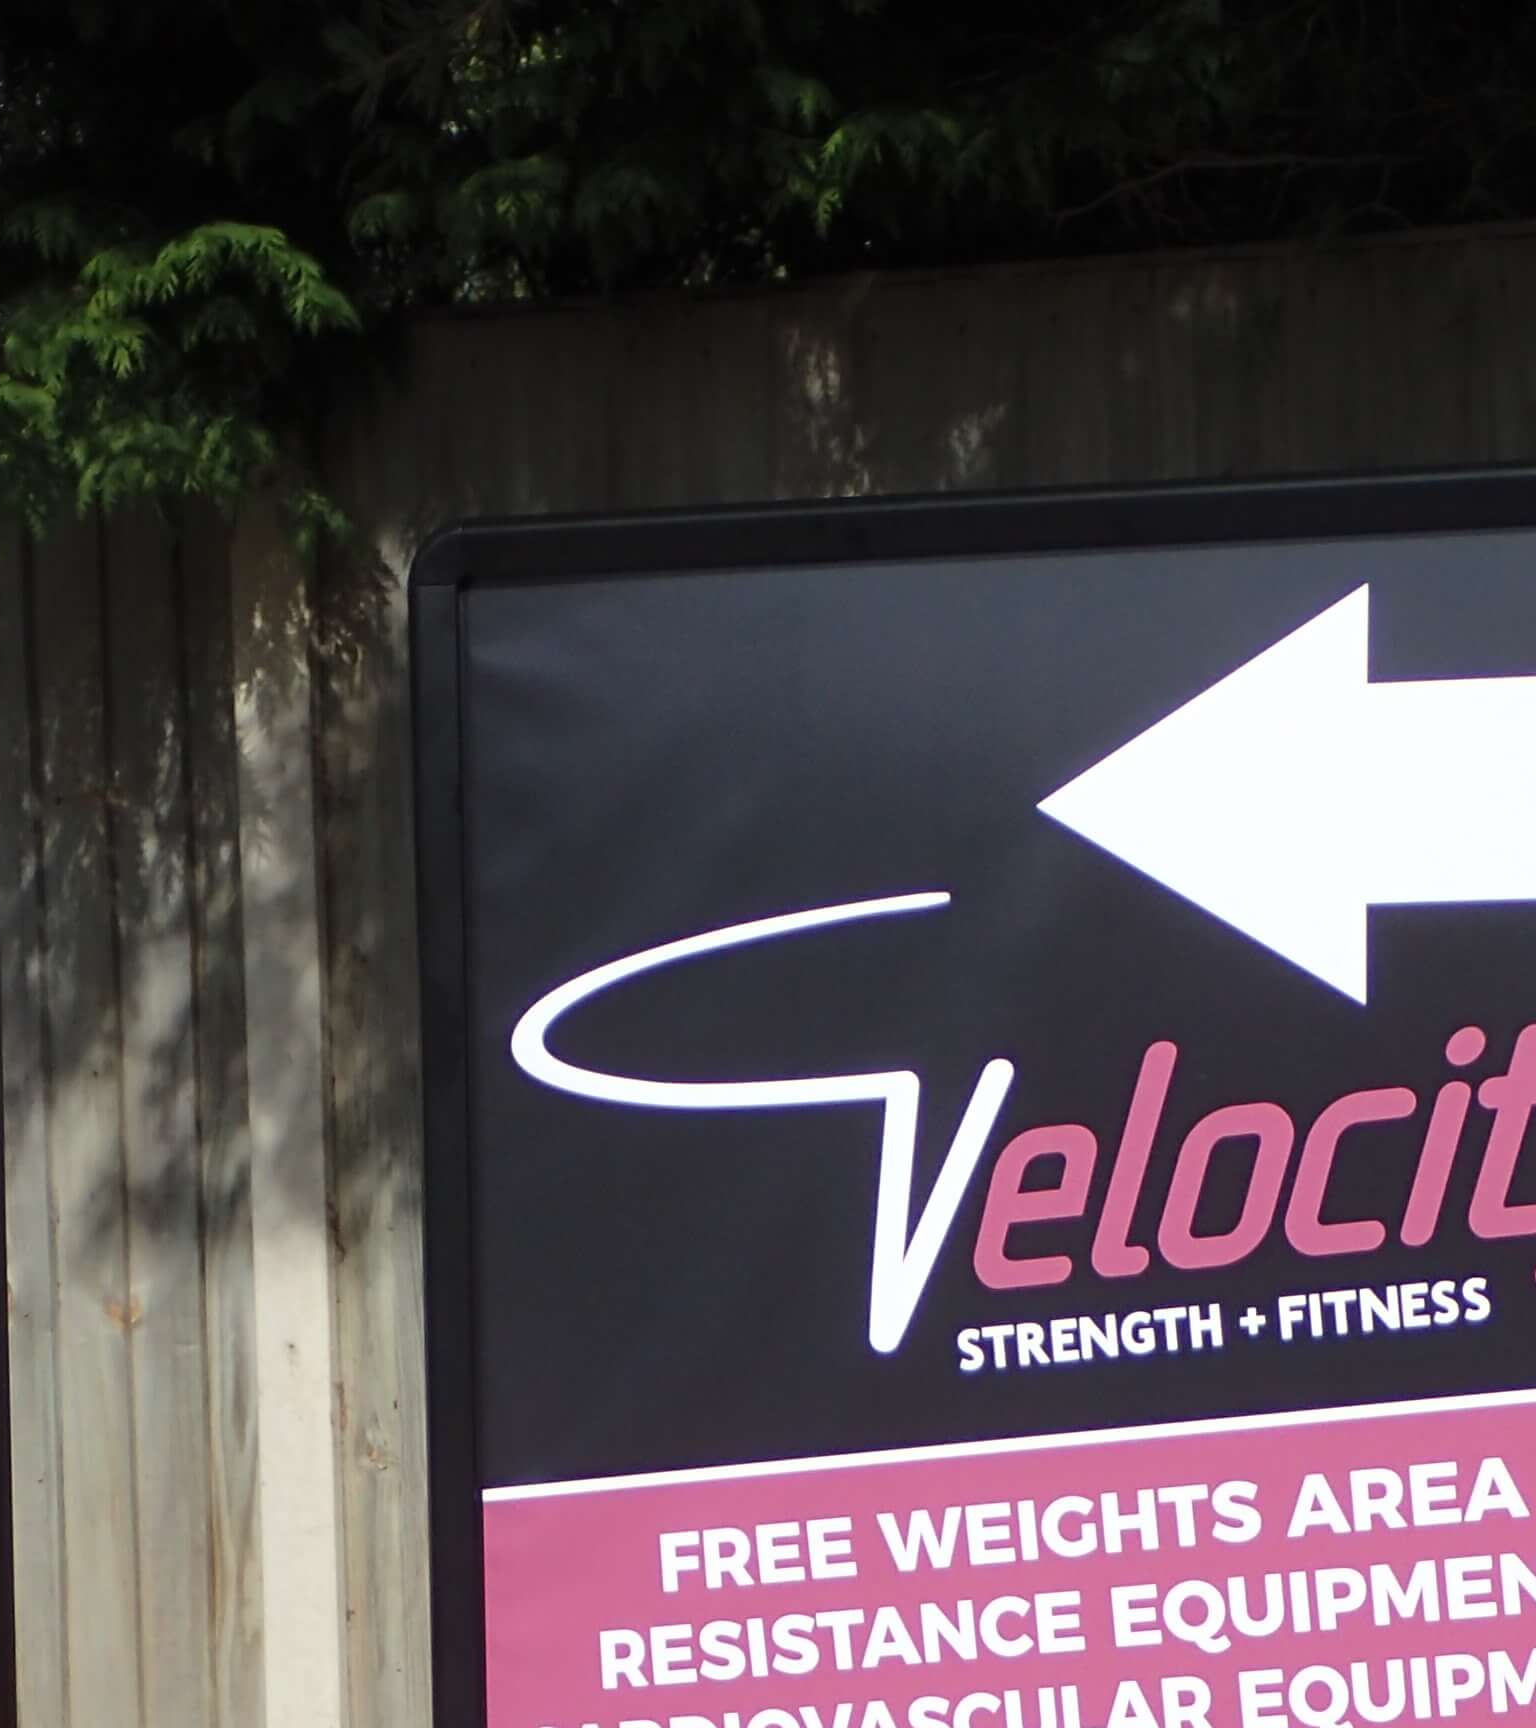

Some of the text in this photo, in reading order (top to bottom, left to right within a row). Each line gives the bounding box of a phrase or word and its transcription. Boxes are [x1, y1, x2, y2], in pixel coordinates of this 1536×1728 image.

[957, 1303, 1224, 1372] STRENGTH
[1278, 1277, 1491, 1341] FITNESS
[659, 1457, 1530, 1593] FREE WEIGHTS AREA
[599, 1590, 1086, 1690] RESISTANCE
